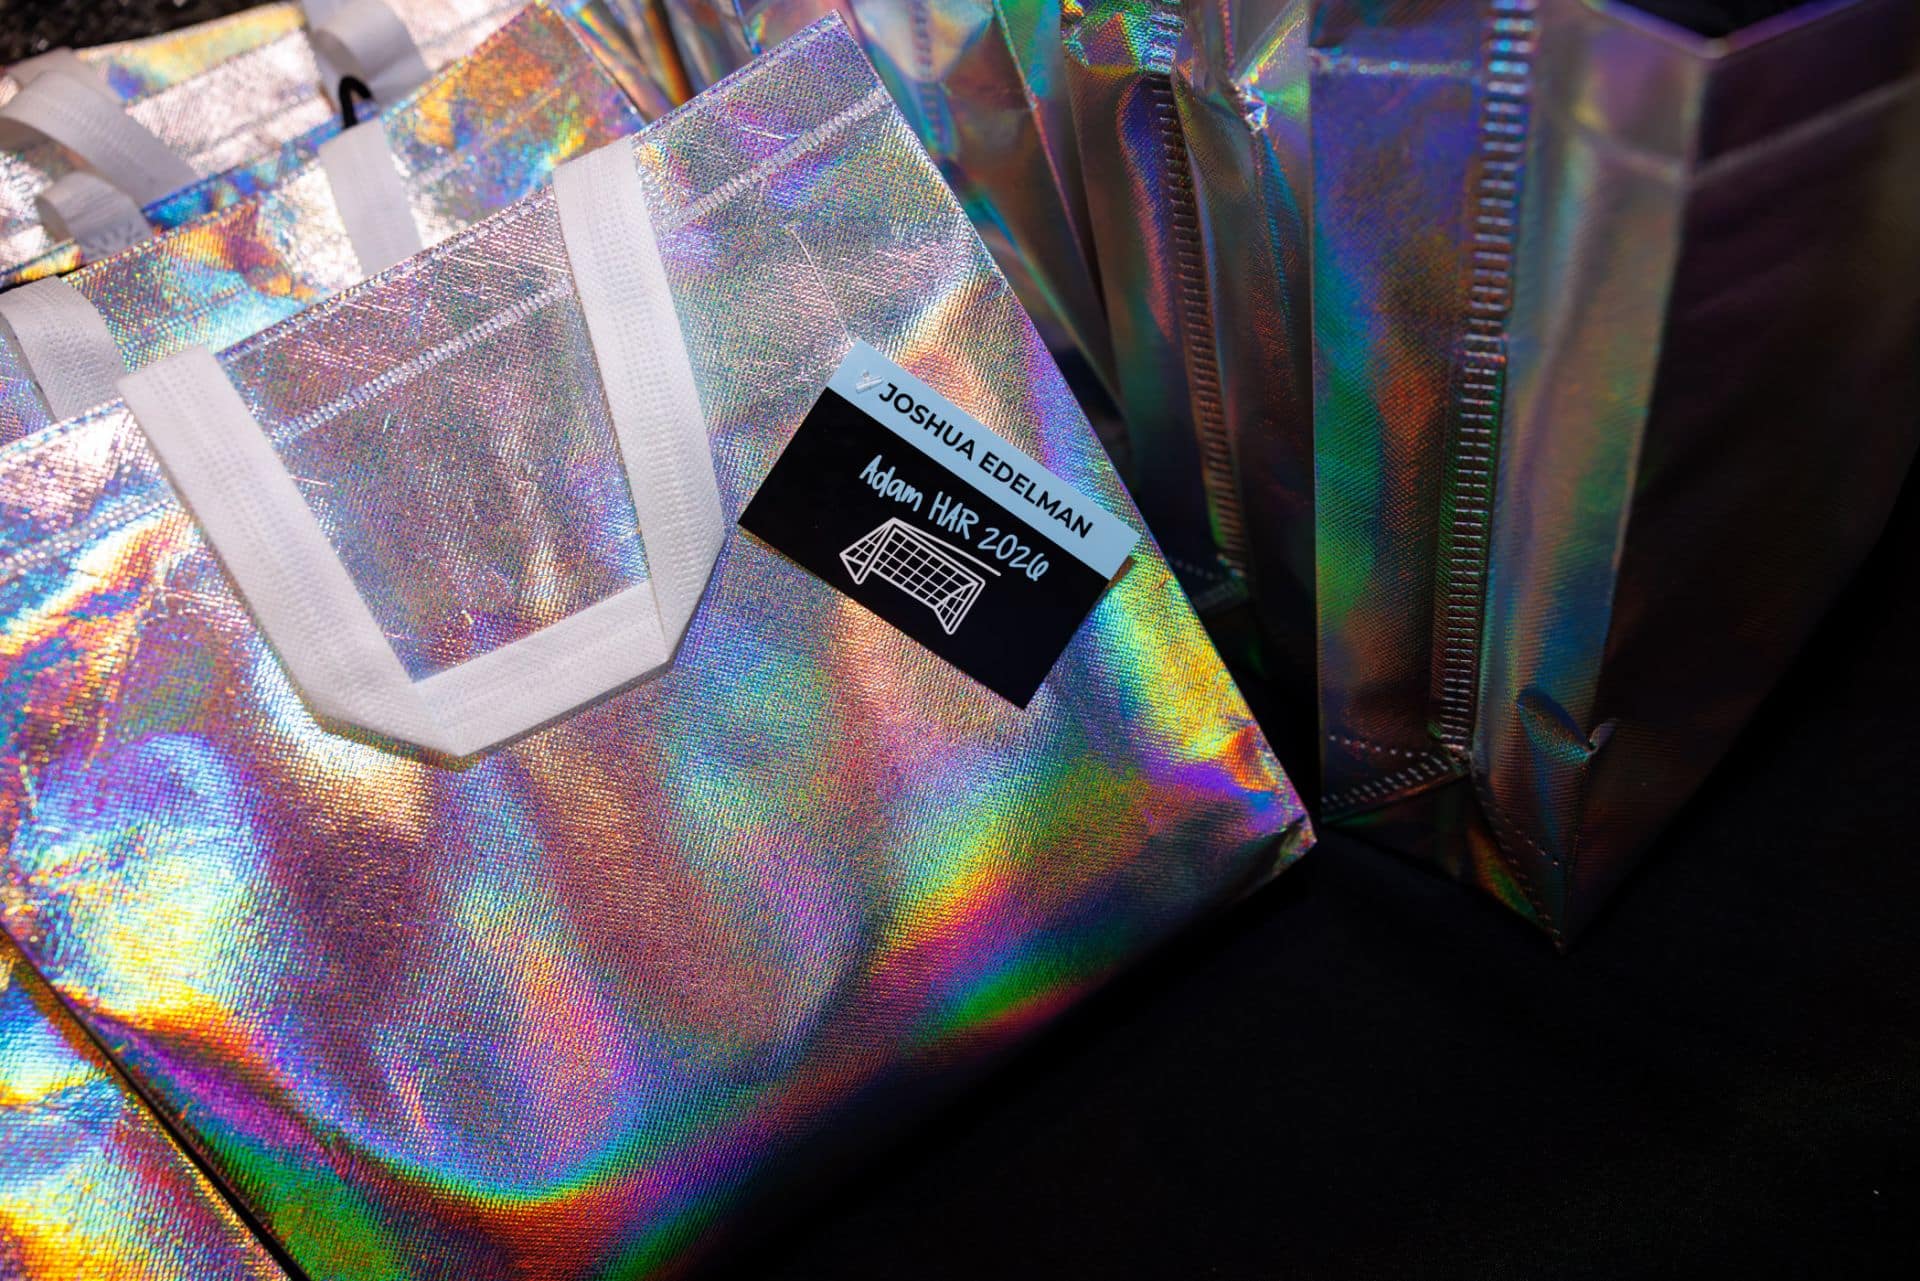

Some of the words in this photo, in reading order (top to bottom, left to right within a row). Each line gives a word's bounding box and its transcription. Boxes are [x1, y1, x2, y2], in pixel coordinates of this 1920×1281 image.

[859, 455, 923, 512] Adam
[928, 492, 979, 540] HAR
[978, 528, 1050, 582] 2026
[879, 382, 975, 460] JOSHUA
[978, 452, 1093, 538] EDELMAN
